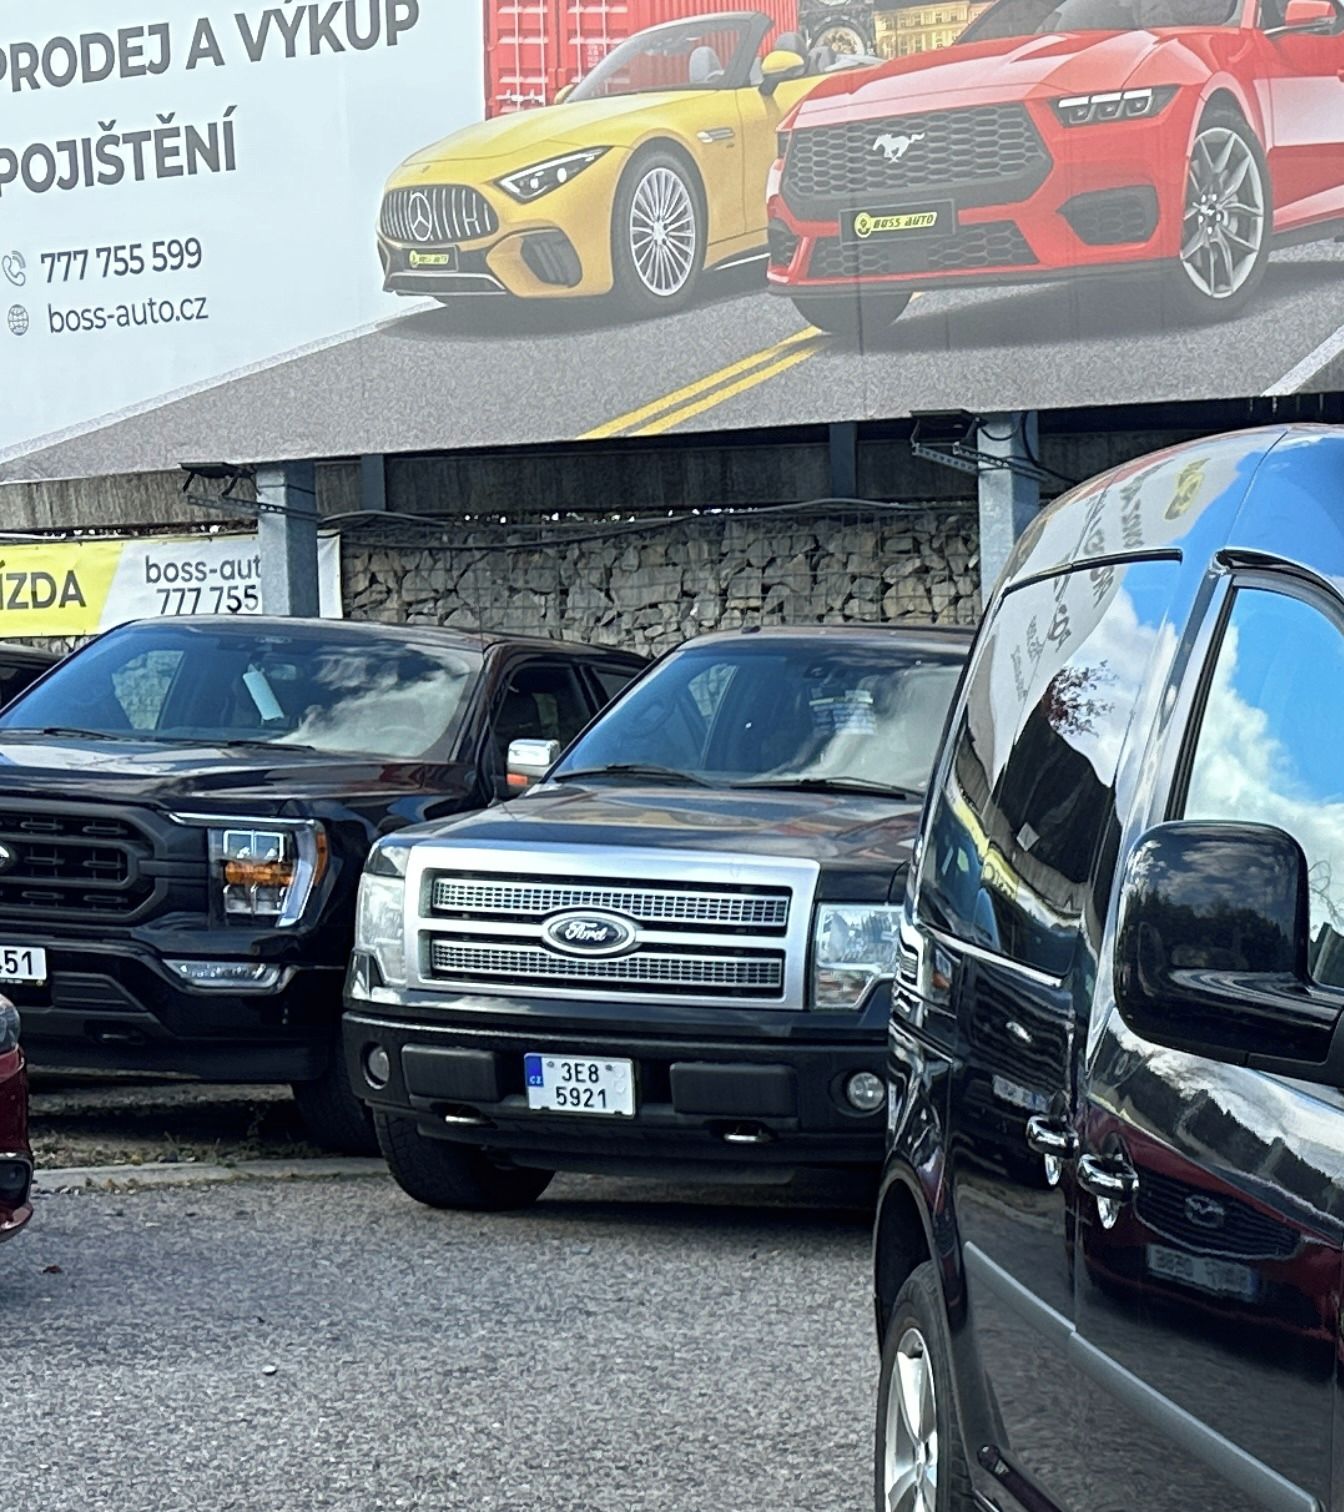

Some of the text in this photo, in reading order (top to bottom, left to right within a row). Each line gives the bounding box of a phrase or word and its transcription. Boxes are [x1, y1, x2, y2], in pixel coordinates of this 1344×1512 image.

[0, 22, 171, 93] RODEJ
[185, 17, 226, 70] A
[0, 104, 238, 197] POJIŠTĚNÍ
[40, 237, 202, 283] 777 755 599
[48, 297, 209, 333] boss-auto.cz
[157, 584, 259, 615] 777 755
[565, 921, 608, 941] Ford
[0, 949, 33, 976] 51
[560, 1062, 600, 1084] 3E8
[555, 1086, 608, 1109] 5921
